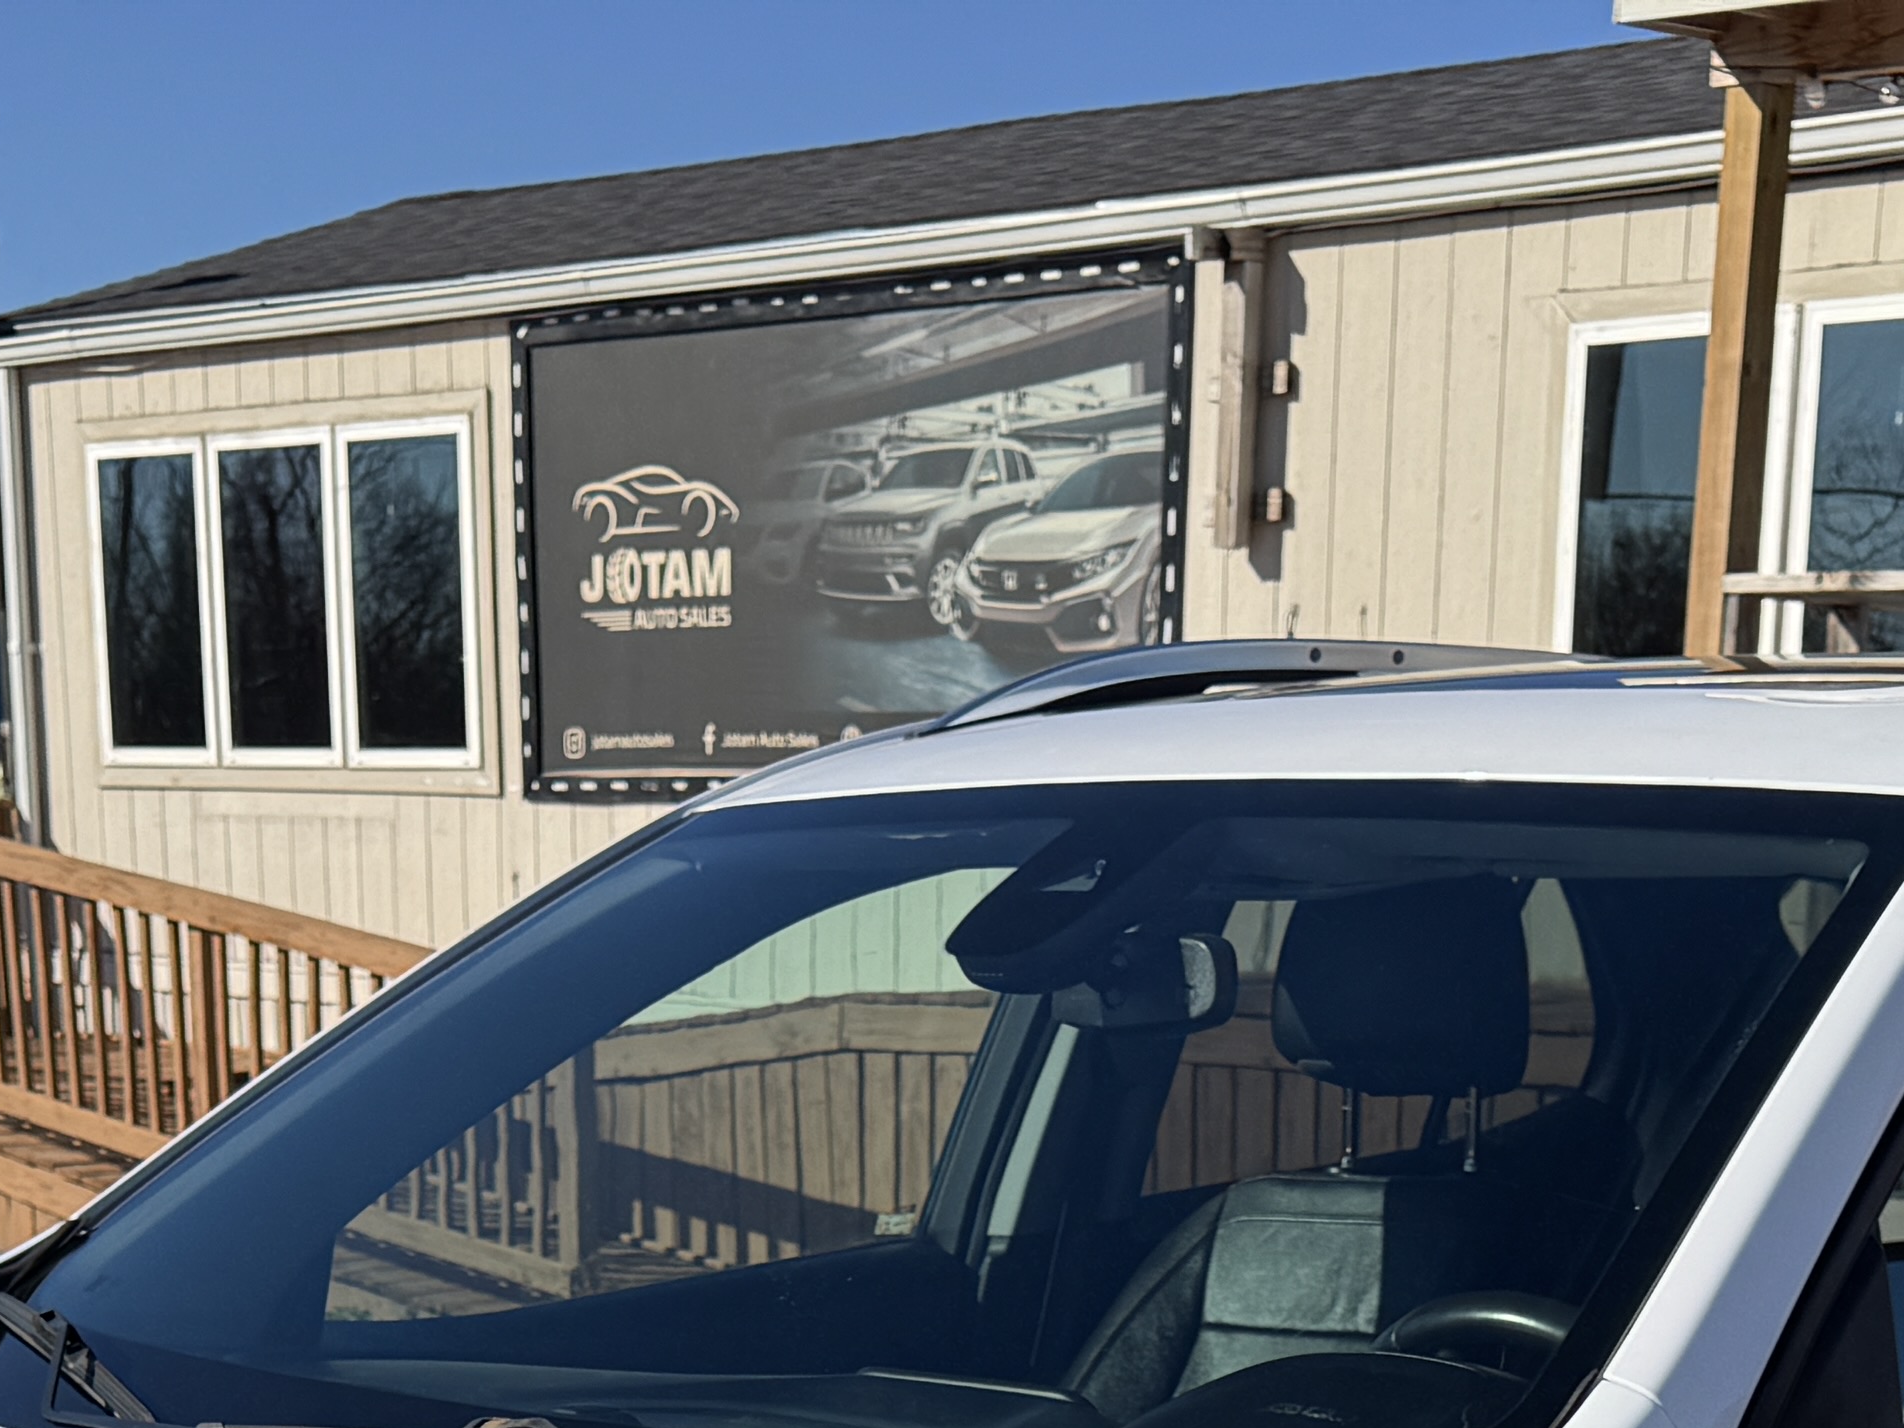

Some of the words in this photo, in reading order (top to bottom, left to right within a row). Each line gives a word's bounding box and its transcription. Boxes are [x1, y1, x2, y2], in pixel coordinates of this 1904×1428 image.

[579, 546, 732, 604] JOTAM
[633, 607, 678, 630] AUTO
[679, 605, 732, 628] SALES
